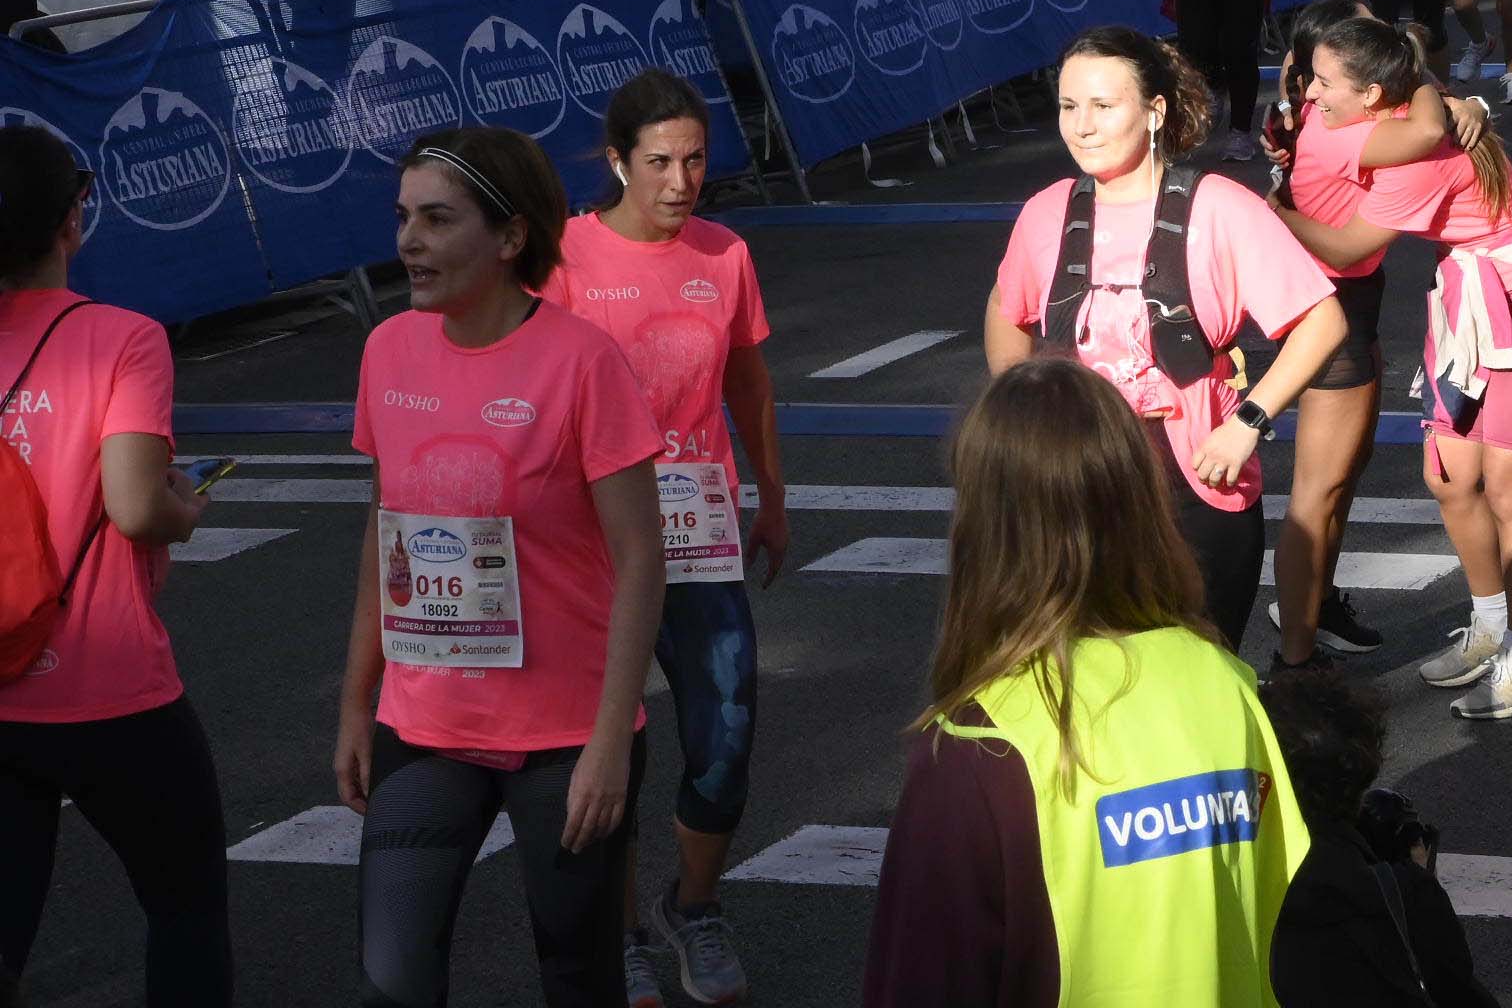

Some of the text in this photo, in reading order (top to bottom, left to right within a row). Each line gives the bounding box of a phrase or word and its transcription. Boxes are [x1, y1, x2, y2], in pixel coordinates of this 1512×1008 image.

[565, 52, 645, 97] ASTURIANA
[470, 67, 563, 115] ASTURIANA
[357, 90, 459, 142] ASTURIANA
[248, 114, 341, 166] ASTURIAN
[112, 143, 224, 203] ASTURIANA
[586, 286, 640, 300] OYSHO
[682, 286, 717, 300] ASTURIANA
[384, 389, 441, 412] OYSHO
[485, 405, 533, 422] ASTURIANA
[664, 429, 712, 458] SAL
[658, 485, 696, 497] TURIANA
[411, 539, 463, 556] ASTURIANA
[471, 537, 503, 546] SUMA
[674, 550, 684, 558] LA
[685, 549, 711, 557] MUJER
[694, 564, 734, 573] Santander
[415, 574, 463, 597] 016
[421, 603, 459, 617] 18092
[393, 621, 505, 633] CARRERA DE LA MUJER 2023
[391, 639, 426, 655] OYSHO
[462, 644, 511, 655] Santander
